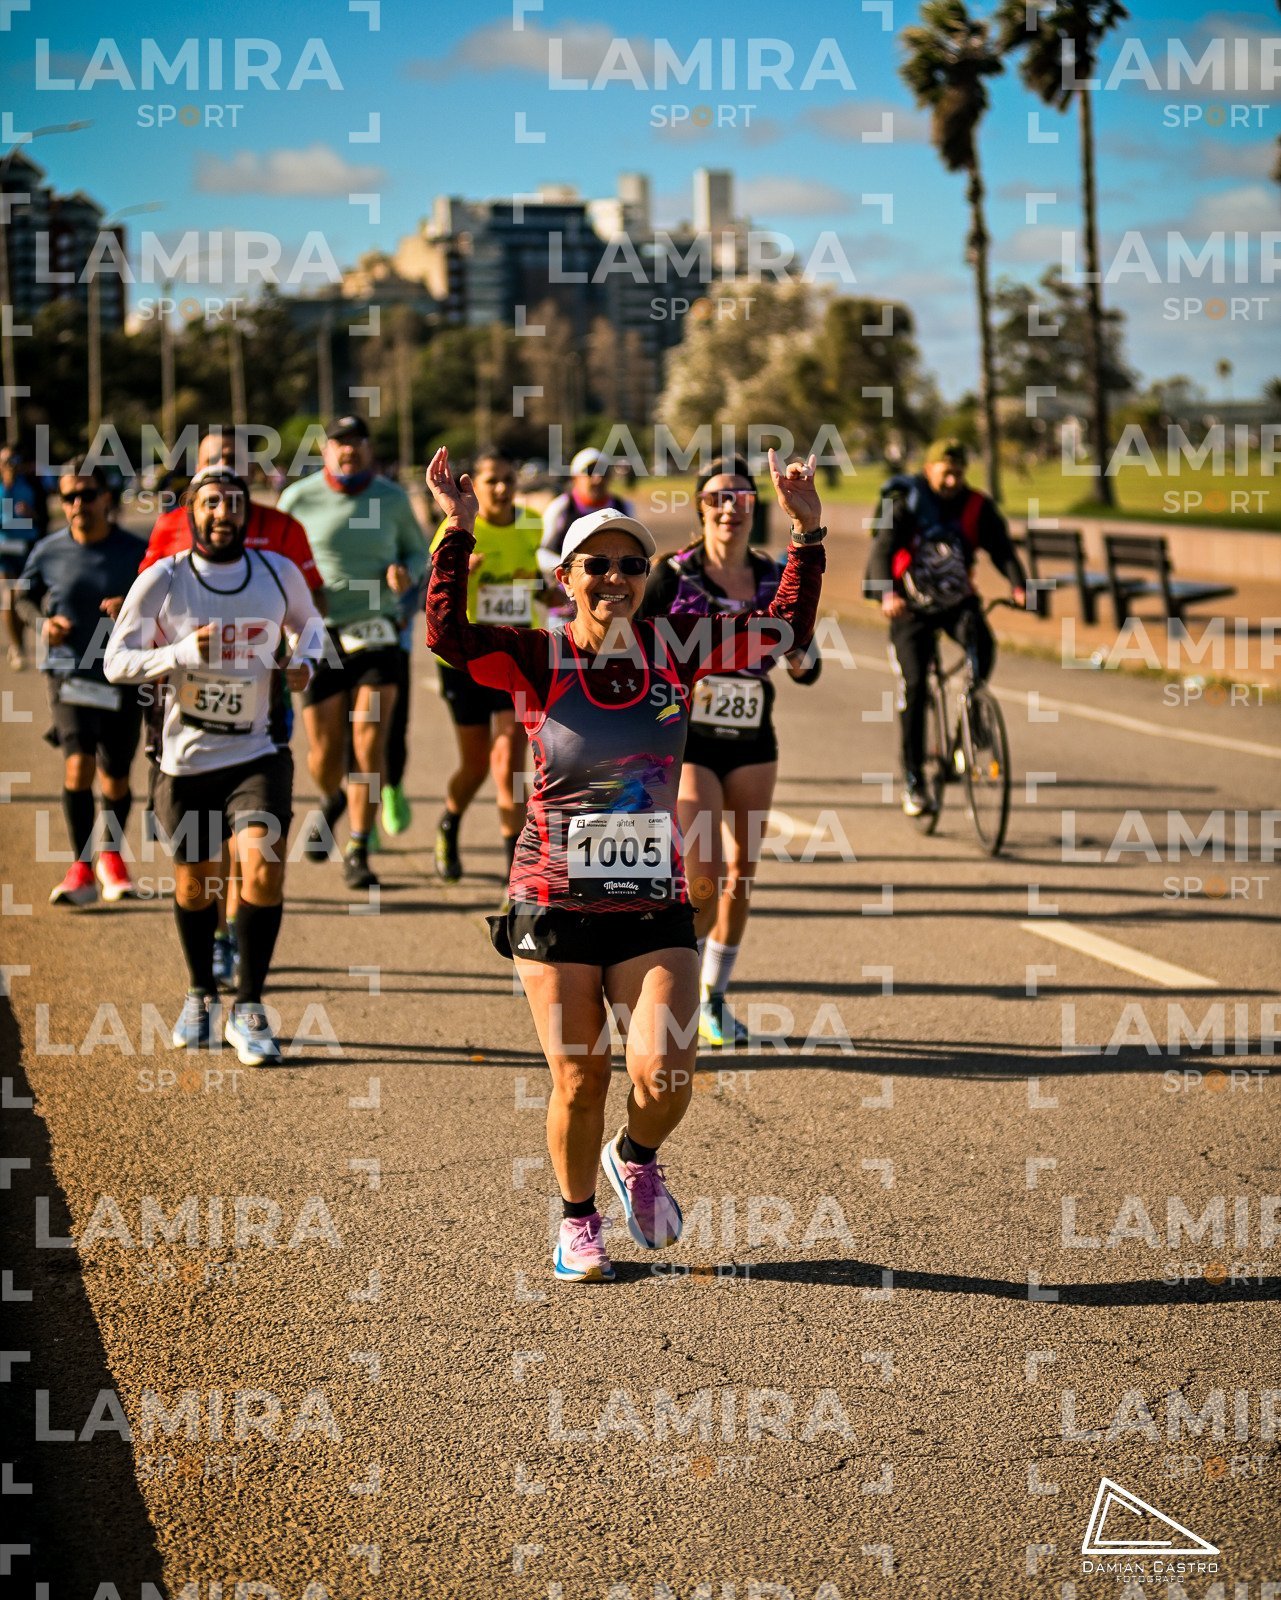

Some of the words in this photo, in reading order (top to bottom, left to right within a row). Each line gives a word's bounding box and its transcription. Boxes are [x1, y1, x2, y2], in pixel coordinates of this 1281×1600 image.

[194, 688, 242, 715] 575
[701, 693, 759, 719] 1283
[577, 836, 662, 867] 1005
